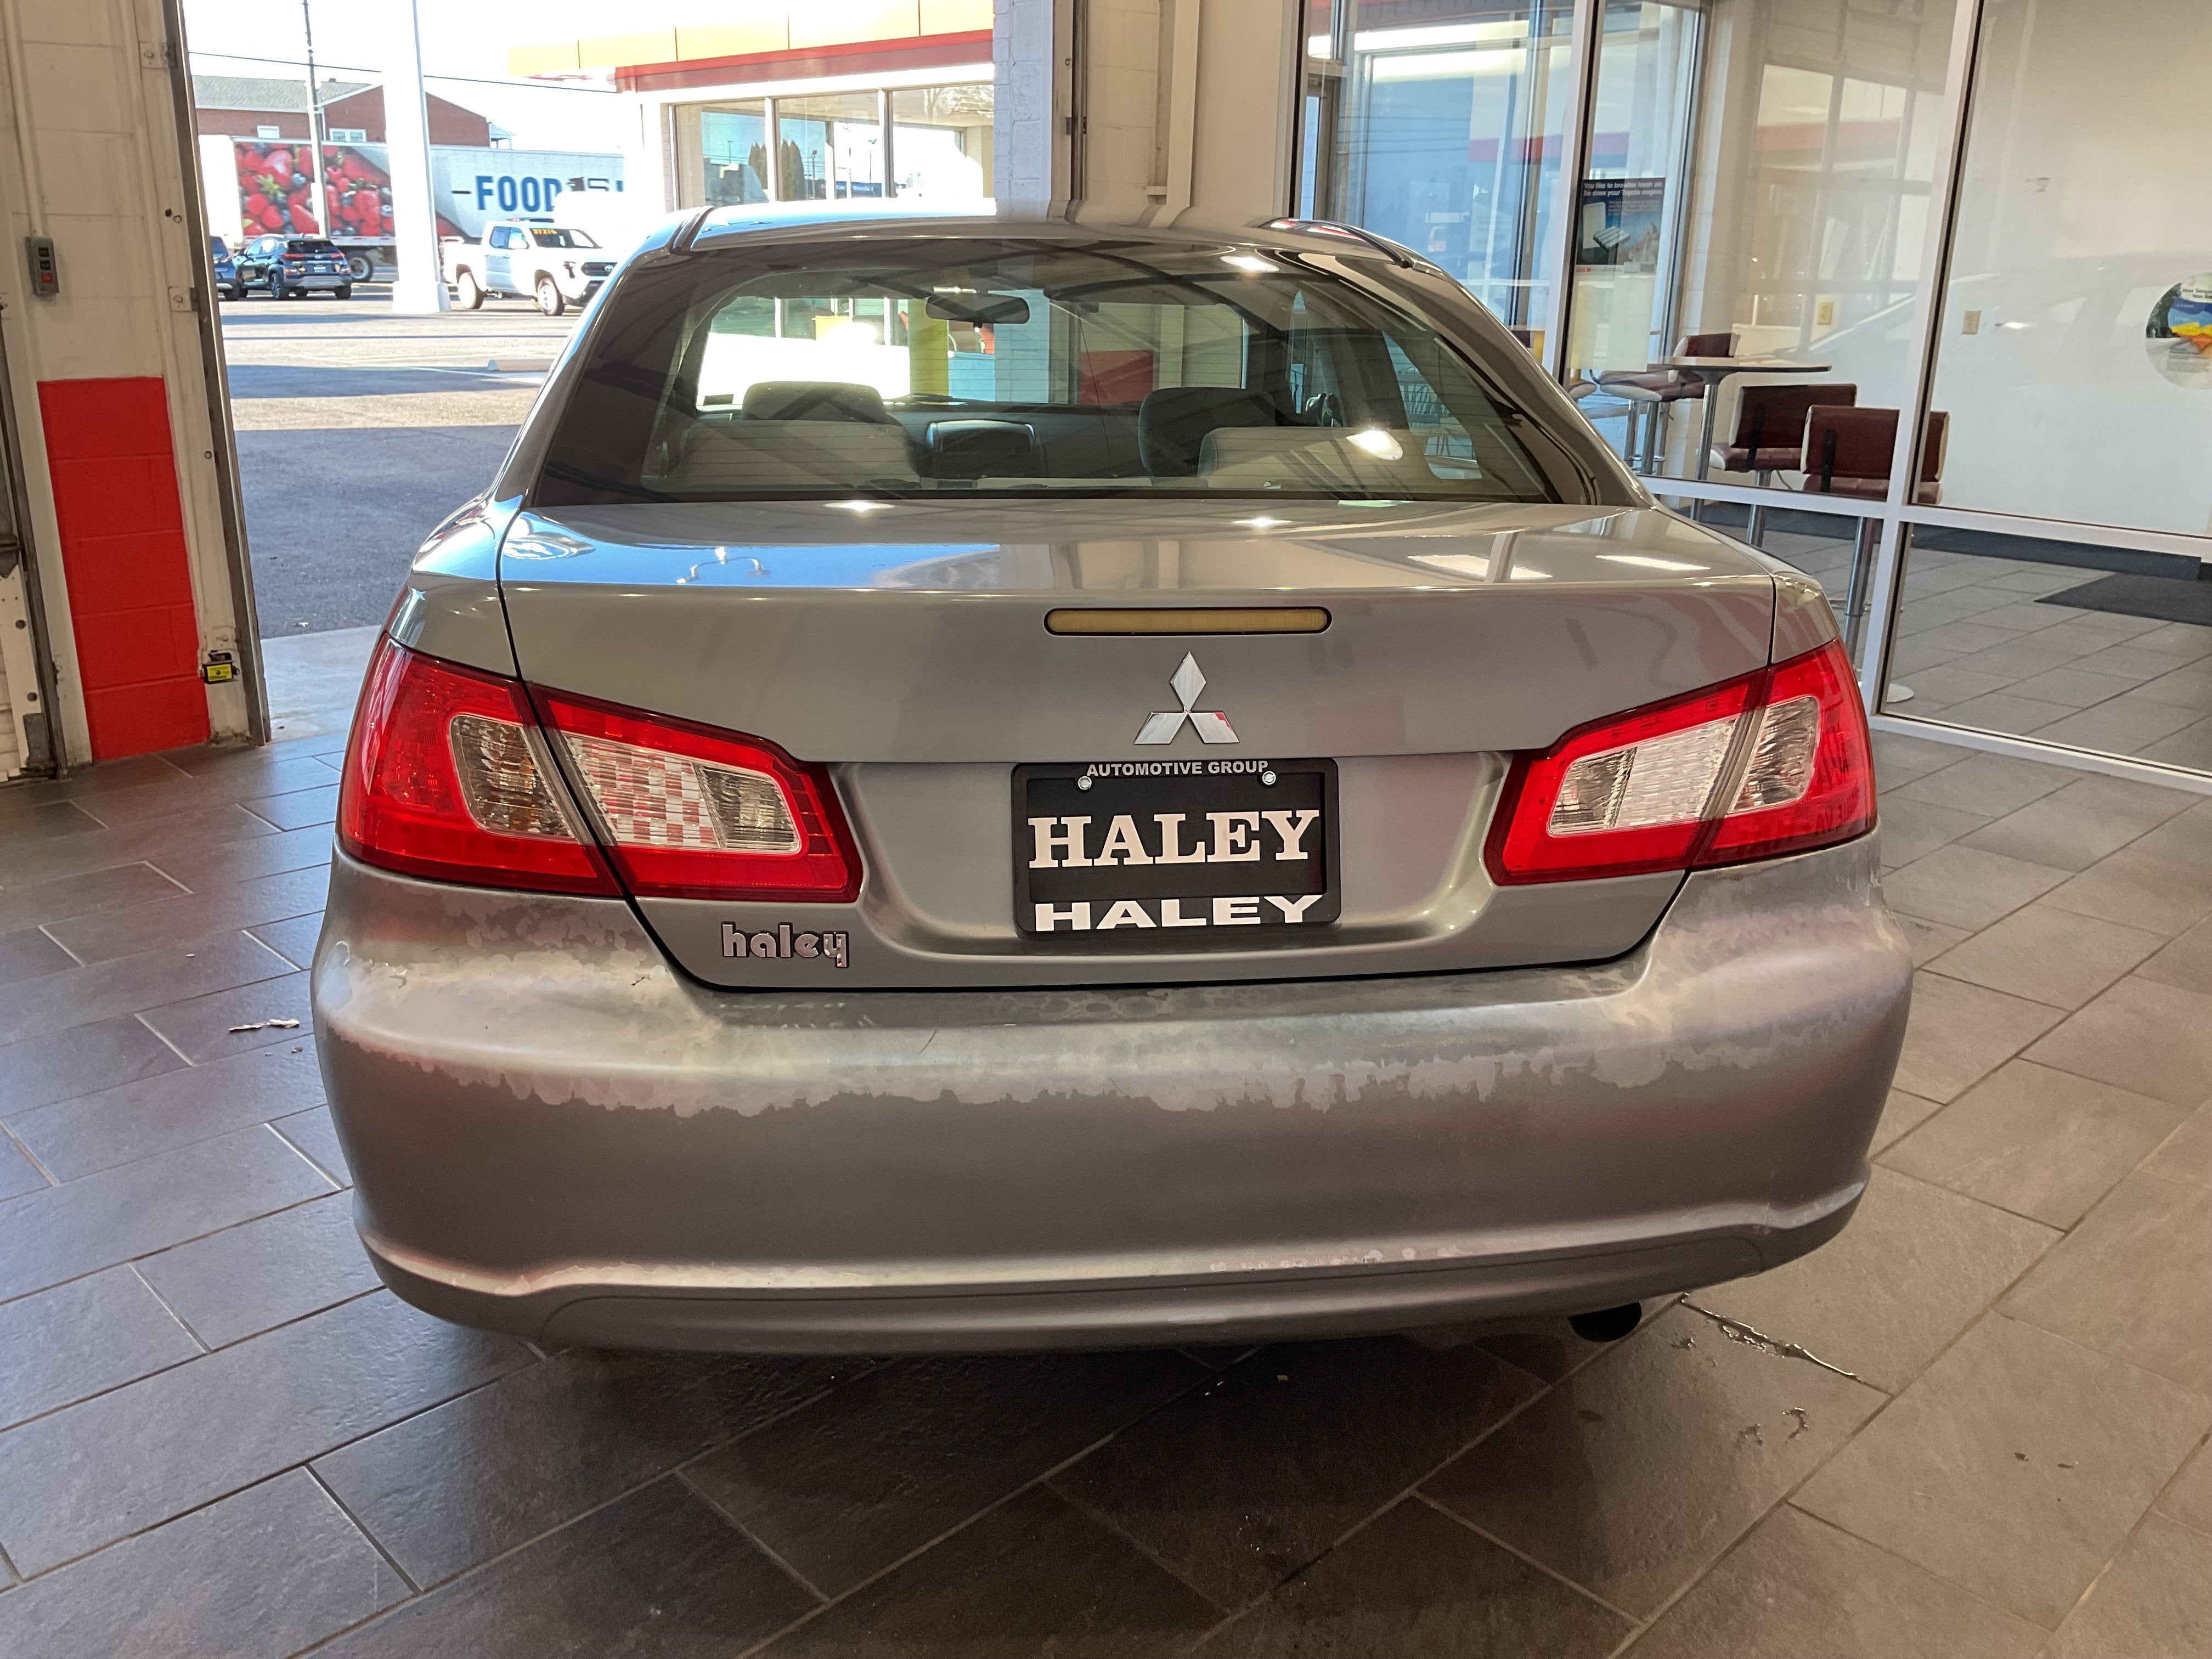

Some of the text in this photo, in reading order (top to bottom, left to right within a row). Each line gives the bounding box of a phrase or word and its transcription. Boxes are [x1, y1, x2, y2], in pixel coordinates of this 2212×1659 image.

[476, 175, 562, 212] FOOD
[1086, 760, 1268, 777] AUTOMOTIVE GROUP
[1028, 810, 1319, 868] HALEY
[1035, 895, 1322, 932] HALEY
[721, 922, 849, 968] haley
